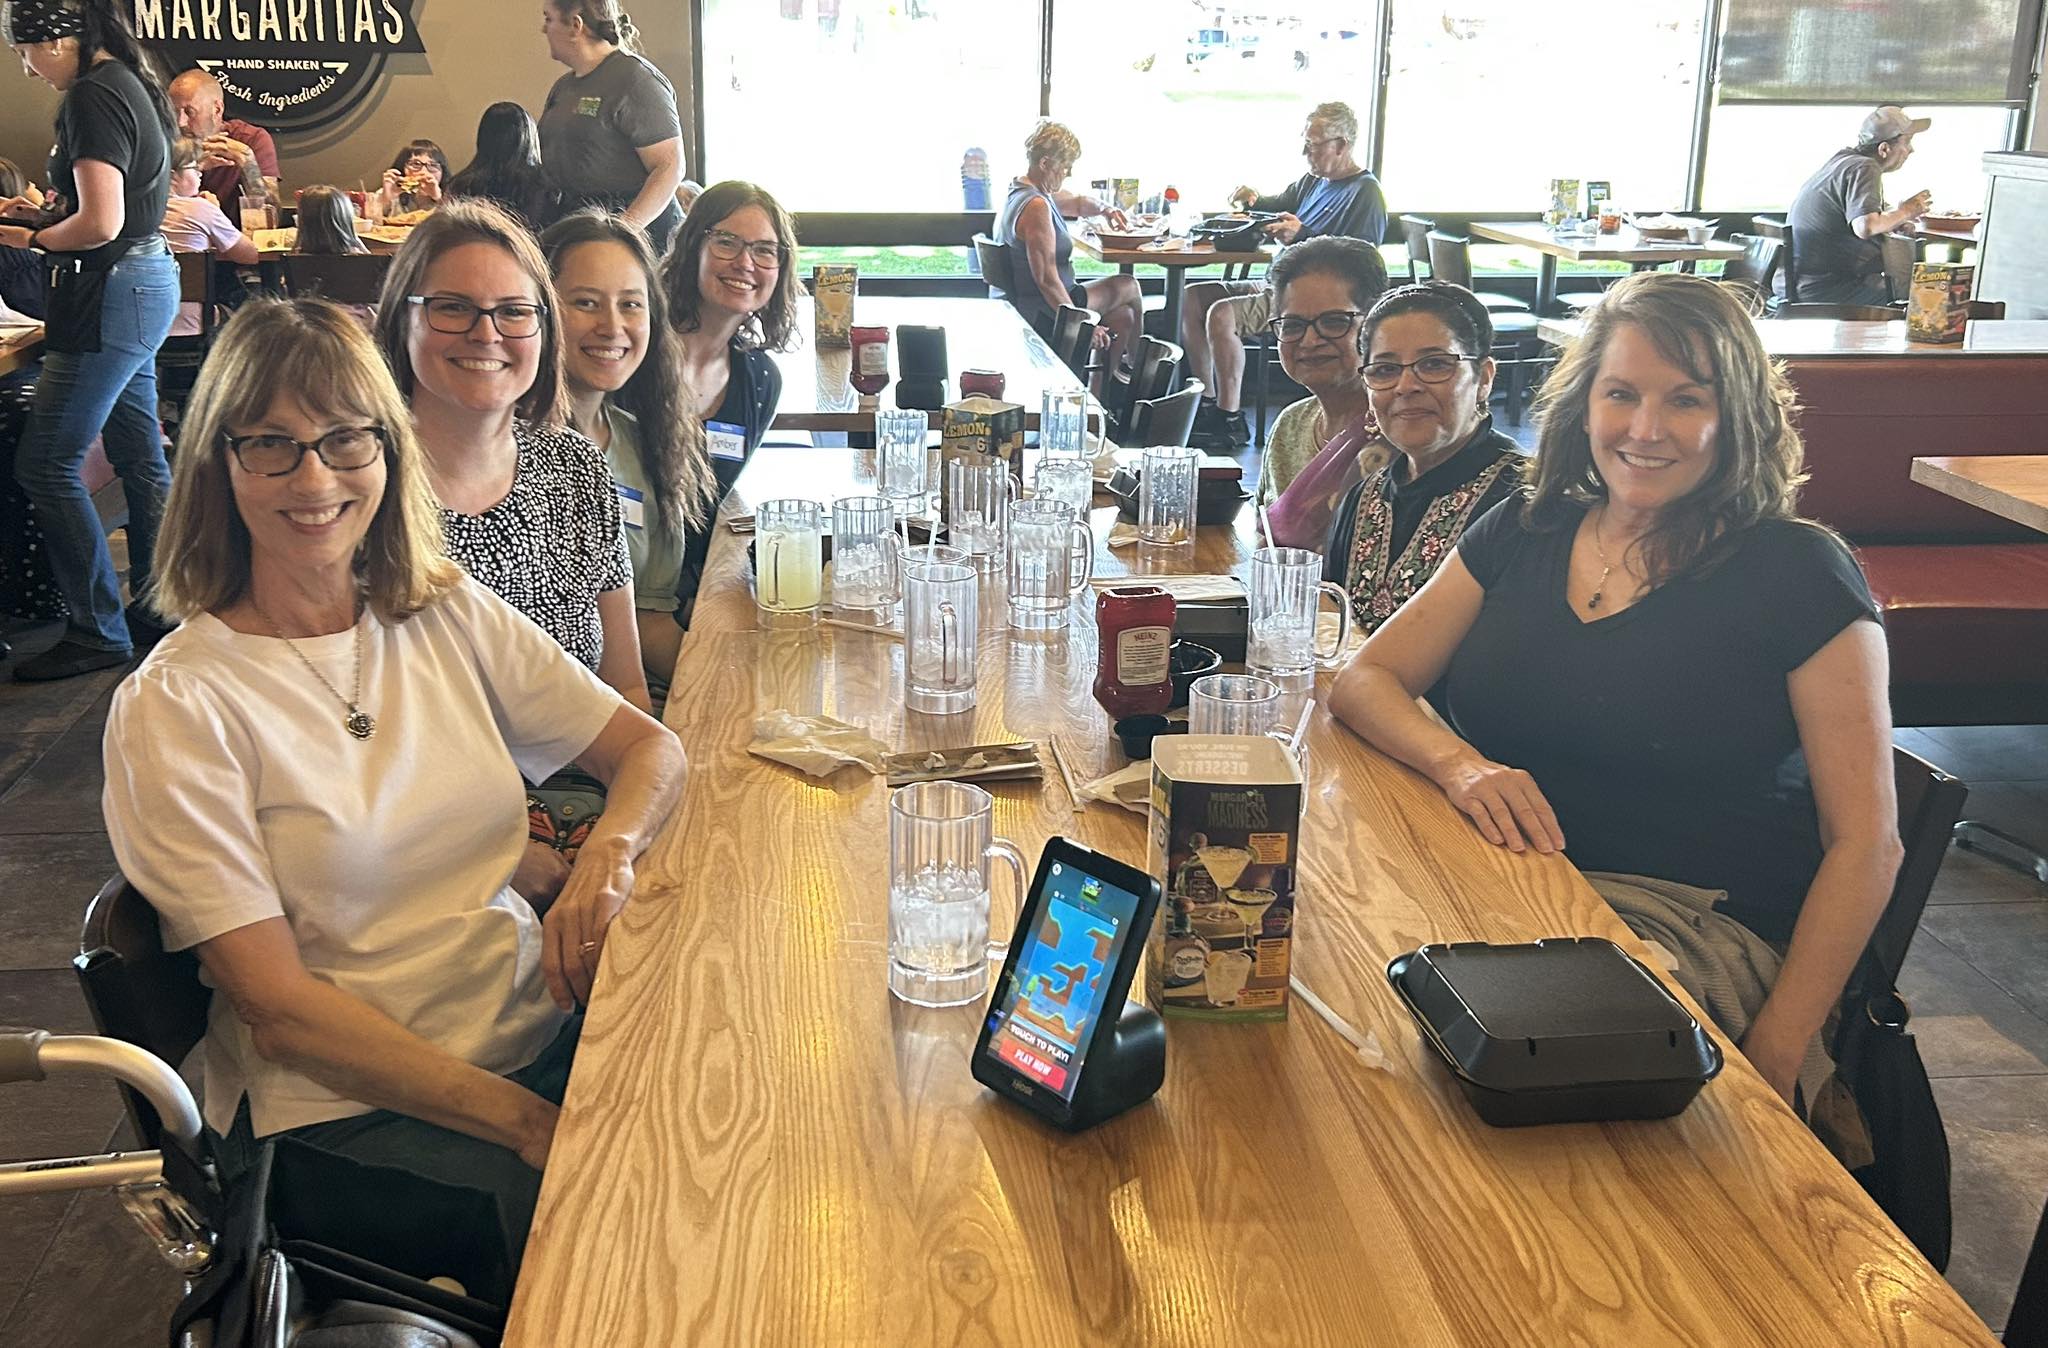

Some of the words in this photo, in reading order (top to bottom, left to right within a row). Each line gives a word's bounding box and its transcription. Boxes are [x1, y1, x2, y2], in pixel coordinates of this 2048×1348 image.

[134, 0, 404, 44] MARGARITAS
[226, 58, 265, 70] HAND
[267, 58, 320, 71] SHAKEN
[214, 70, 252, 101] Fresh
[258, 74, 336, 112] Ingredients
[943, 421, 987, 438] LEMON
[976, 437, 987, 453] 6
[1133, 631, 1159, 641] HEINZ
[1207, 800, 1269, 829] MADNESS
[1010, 1023, 1036, 1045] TOUCH
[1036, 1038, 1048, 1050] TO
[1014, 1048, 1034, 1066] PLAY
[1032, 1059, 1052, 1077] NOW
